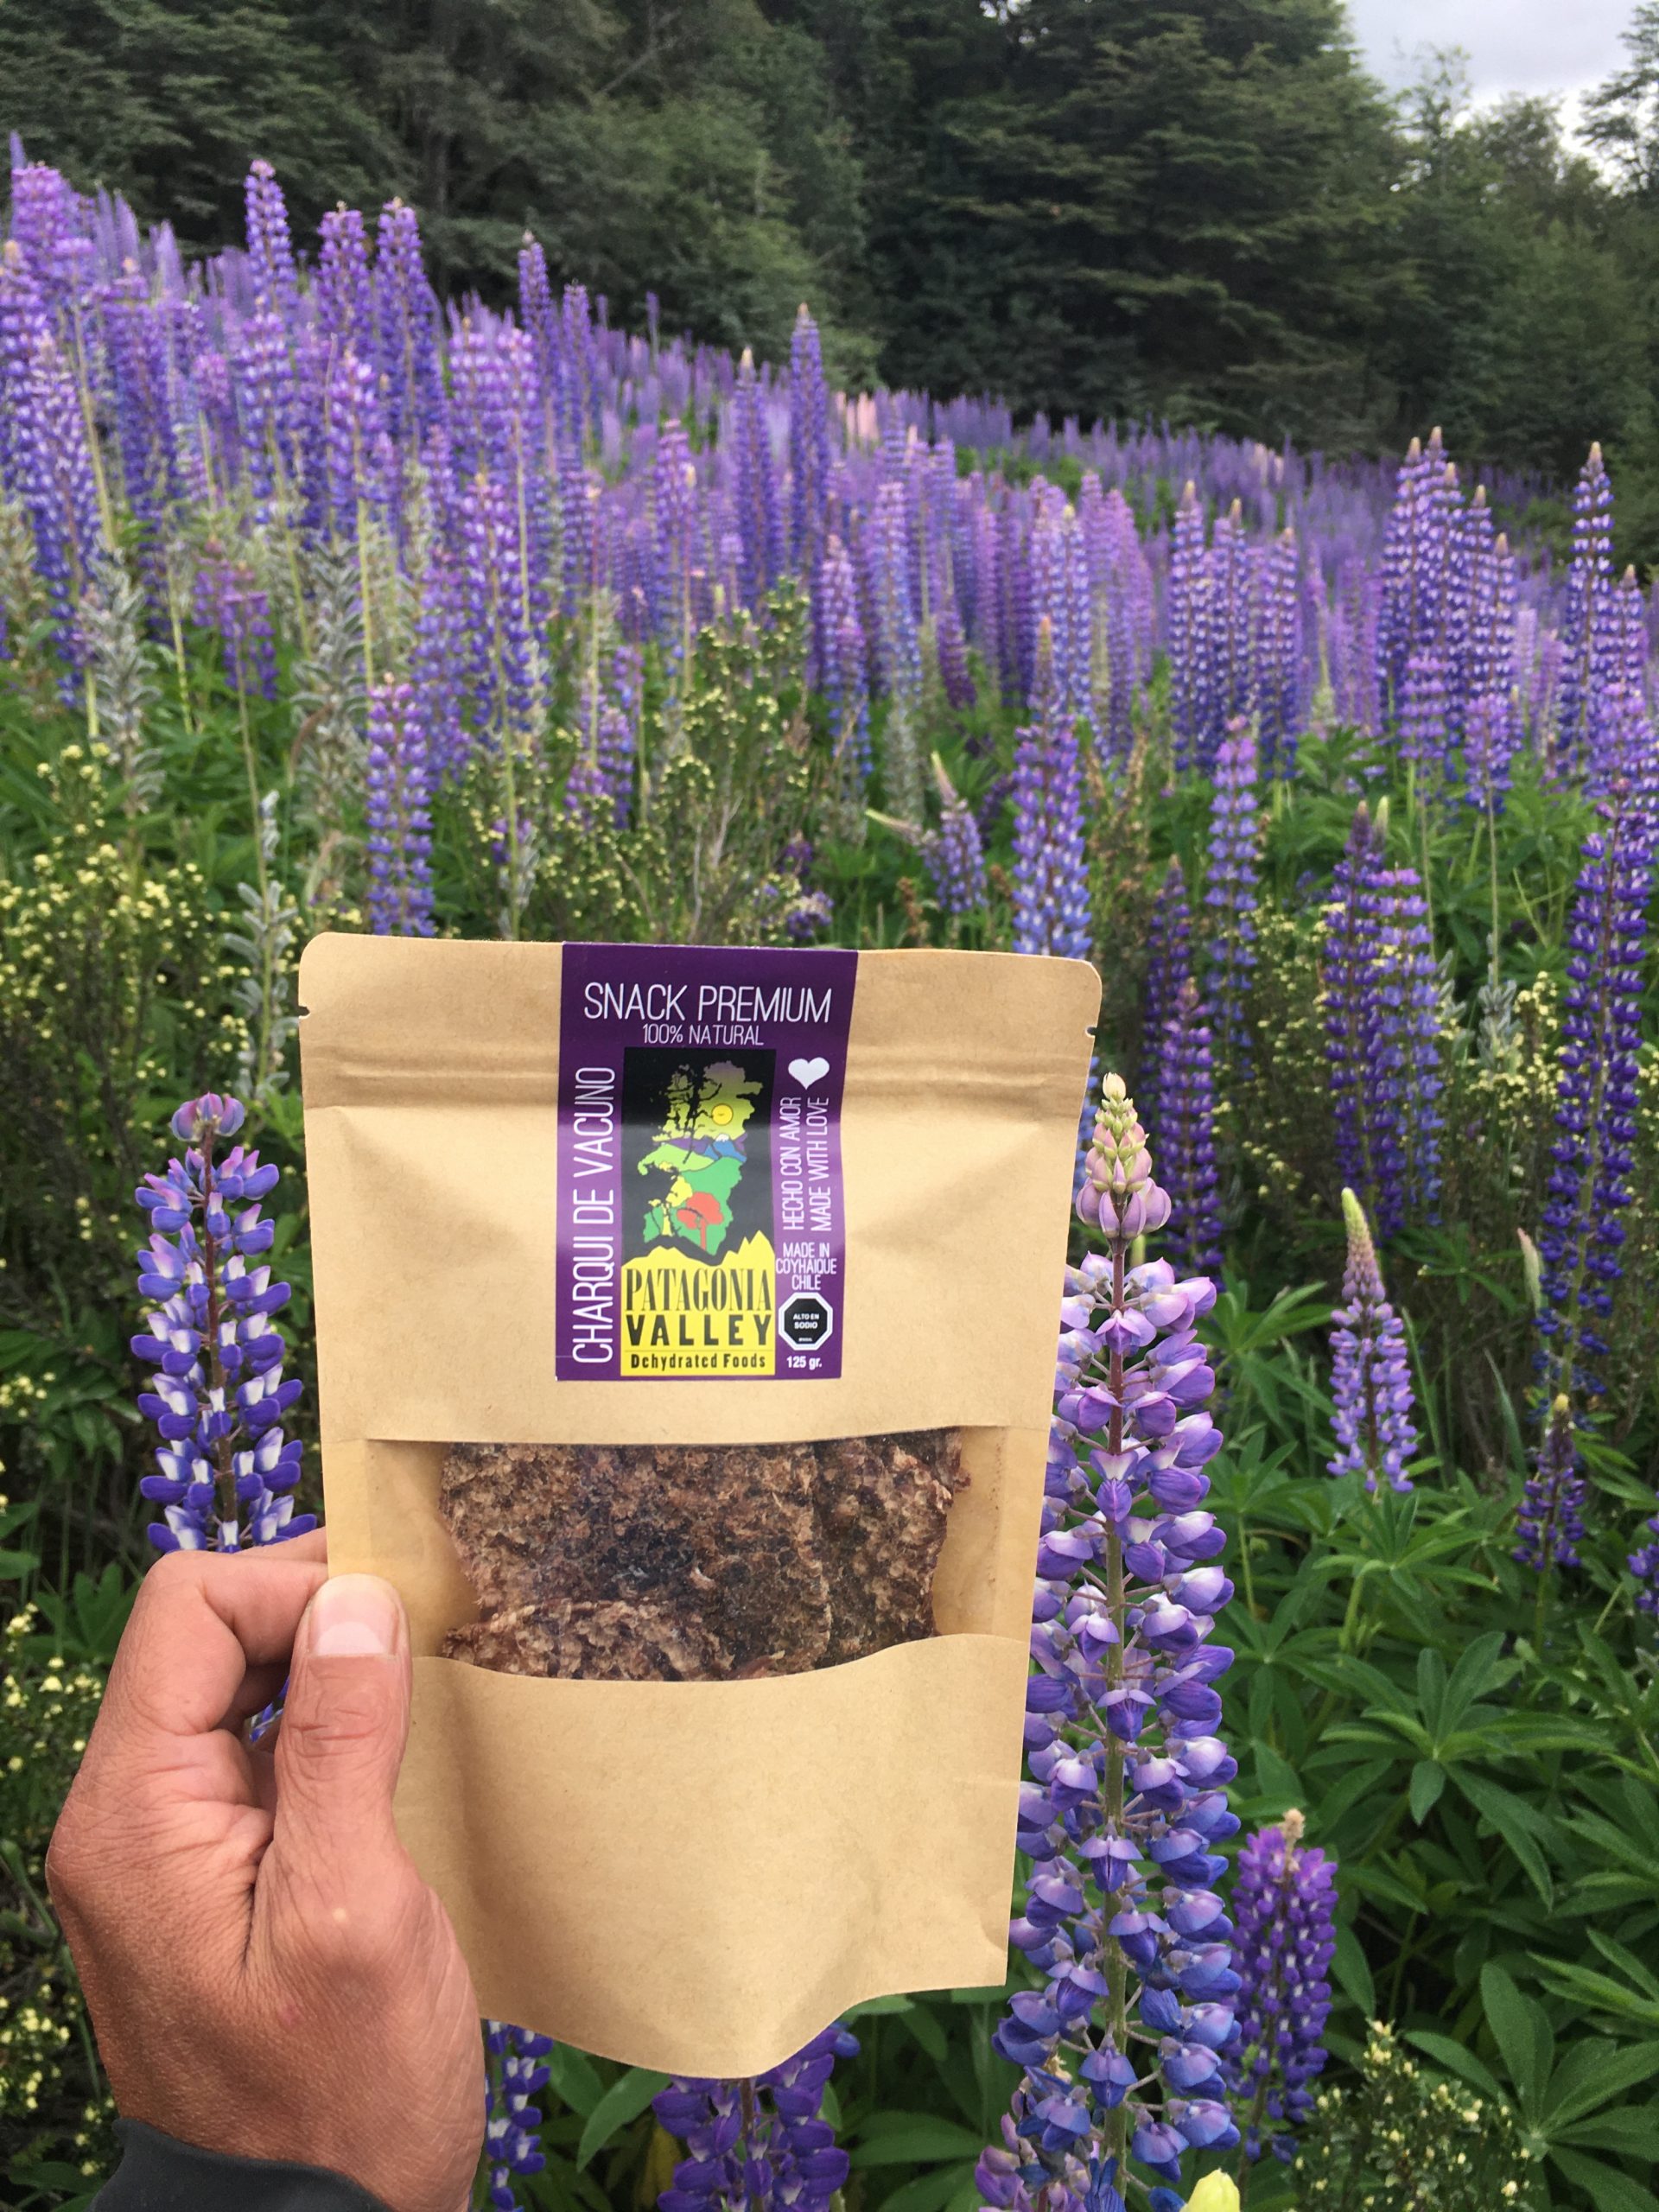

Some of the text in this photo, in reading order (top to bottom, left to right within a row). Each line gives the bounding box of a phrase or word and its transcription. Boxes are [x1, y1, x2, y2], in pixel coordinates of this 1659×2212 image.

[584, 982, 832, 1023] SNACK PREMIUM
[642, 1023, 764, 1046] 100% NATURAL
[779, 1096, 804, 1230] HECHO CON AMOR
[806, 1096, 832, 1231] MADE WITH LOVE
[572, 1067, 615, 1363] CHARQUI DE VACUNO
[783, 1242, 830, 1258] MADE IN
[775, 1258, 837, 1274] COYHAIQUE
[626, 1268, 772, 1312] PATAGONIA
[791, 1274, 821, 1290] CHILE
[626, 1314, 772, 1346] VALLEY
[631, 1352, 766, 1370] Dehydrated Foods
[786, 1356, 822, 1370] 125 gr.
